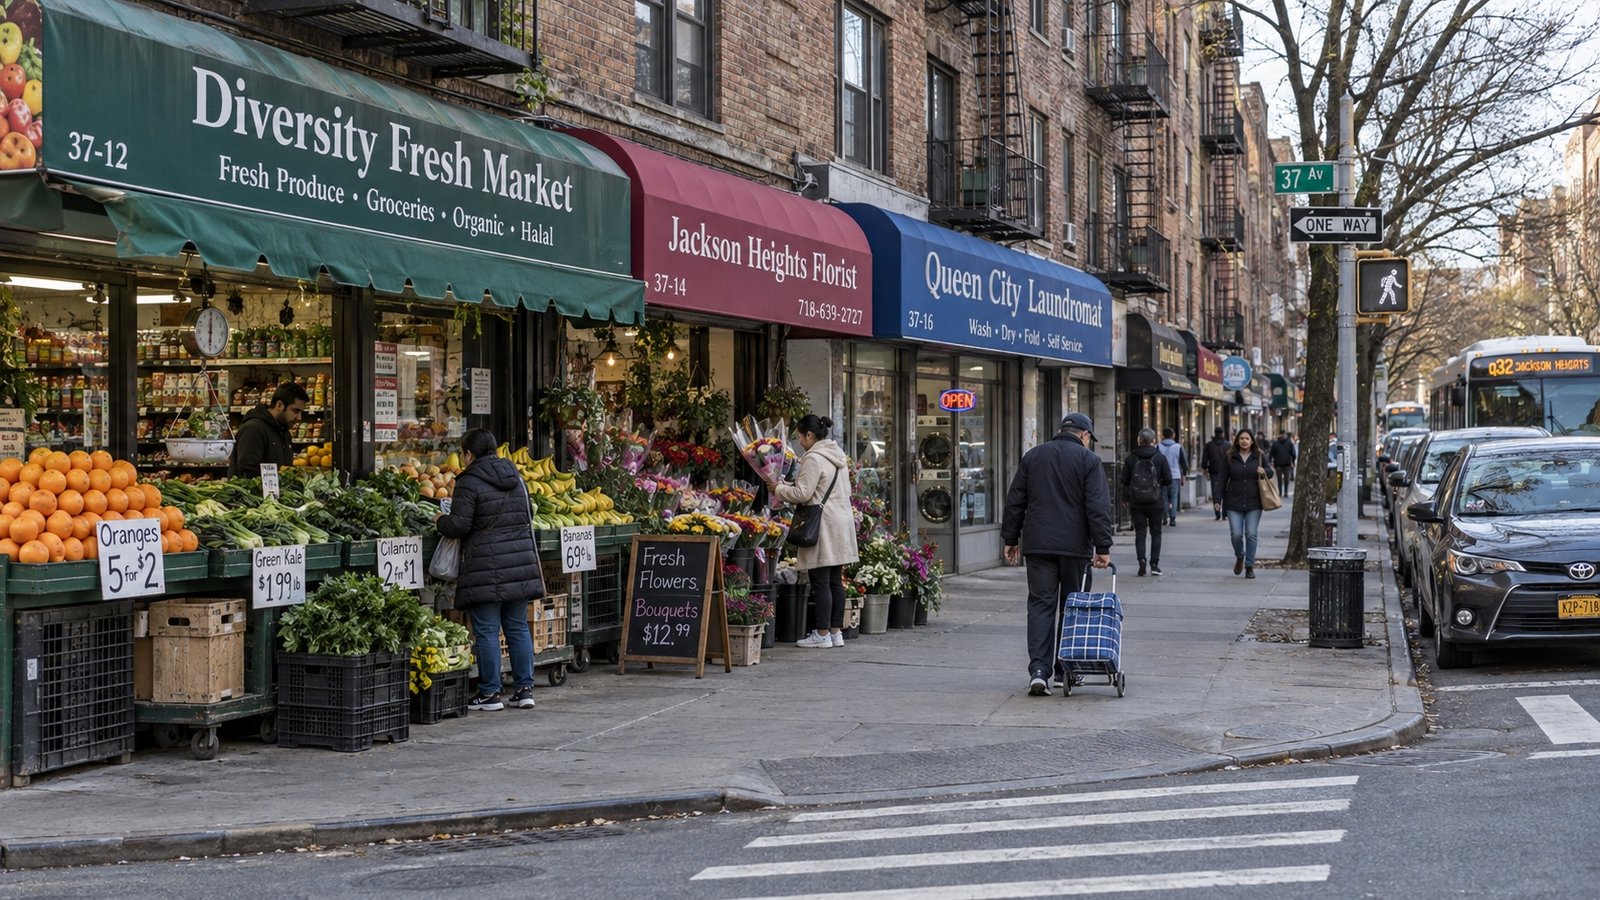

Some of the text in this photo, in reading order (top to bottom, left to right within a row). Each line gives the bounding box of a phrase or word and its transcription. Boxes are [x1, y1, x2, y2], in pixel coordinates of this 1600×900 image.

[68, 131, 128, 170] 37-12
[192, 66, 573, 213] Diversity Fresh Market
[1281, 167, 1324, 189] 37 Av
[219, 155, 554, 246] Fresh Produce Groceries Organic Halal
[1306, 218, 1370, 232] ONE WAY
[668, 216, 858, 290] Jackson Heights Florist
[654, 273, 687, 296] 37-14
[924, 251, 1103, 328] Queen City Laundromat
[798, 299, 863, 325] 718-639-2727
[908, 310, 934, 331] 37-16
[969, 318, 1083, 353] Wash Dry Fold Self Service
[941, 391, 973, 408] OPEN
[101, 523, 159, 551] Oranges
[381, 540, 418, 556] Cilantro
[563, 529, 592, 543] Bananas
[255, 548, 302, 568] Green Kale
[643, 546, 685, 566] Fresh
[108, 552, 159, 593] 5 for $2
[293, 576, 300, 591] lb
[383, 561, 393, 587] 2
[404, 559, 417, 585] $1
[635, 598, 698, 623] Bouquets
